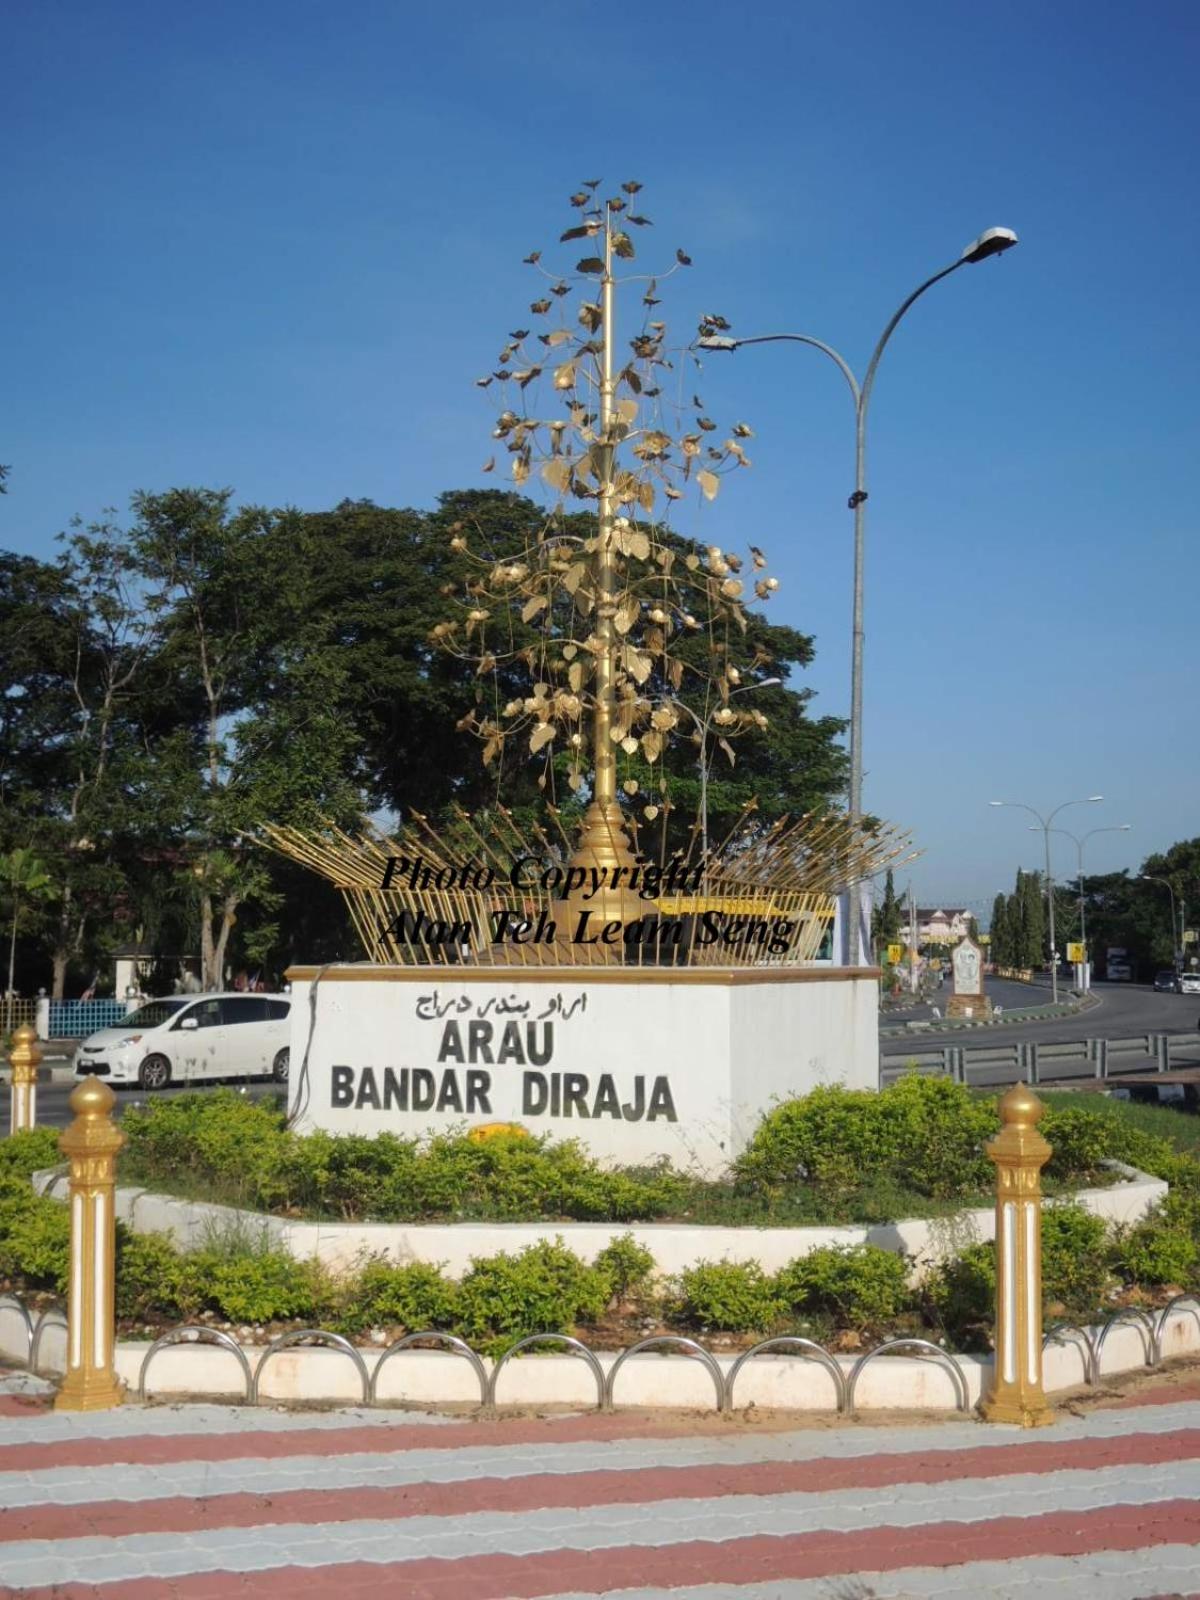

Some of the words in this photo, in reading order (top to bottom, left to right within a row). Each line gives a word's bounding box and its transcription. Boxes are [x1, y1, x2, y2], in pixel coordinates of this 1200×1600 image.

[477, 994, 531, 1019] بندر
[437, 1019, 554, 1066] ARAU
[330, 1065, 493, 1115] BANDAR
[522, 1071, 678, 1122] DIRAJA
